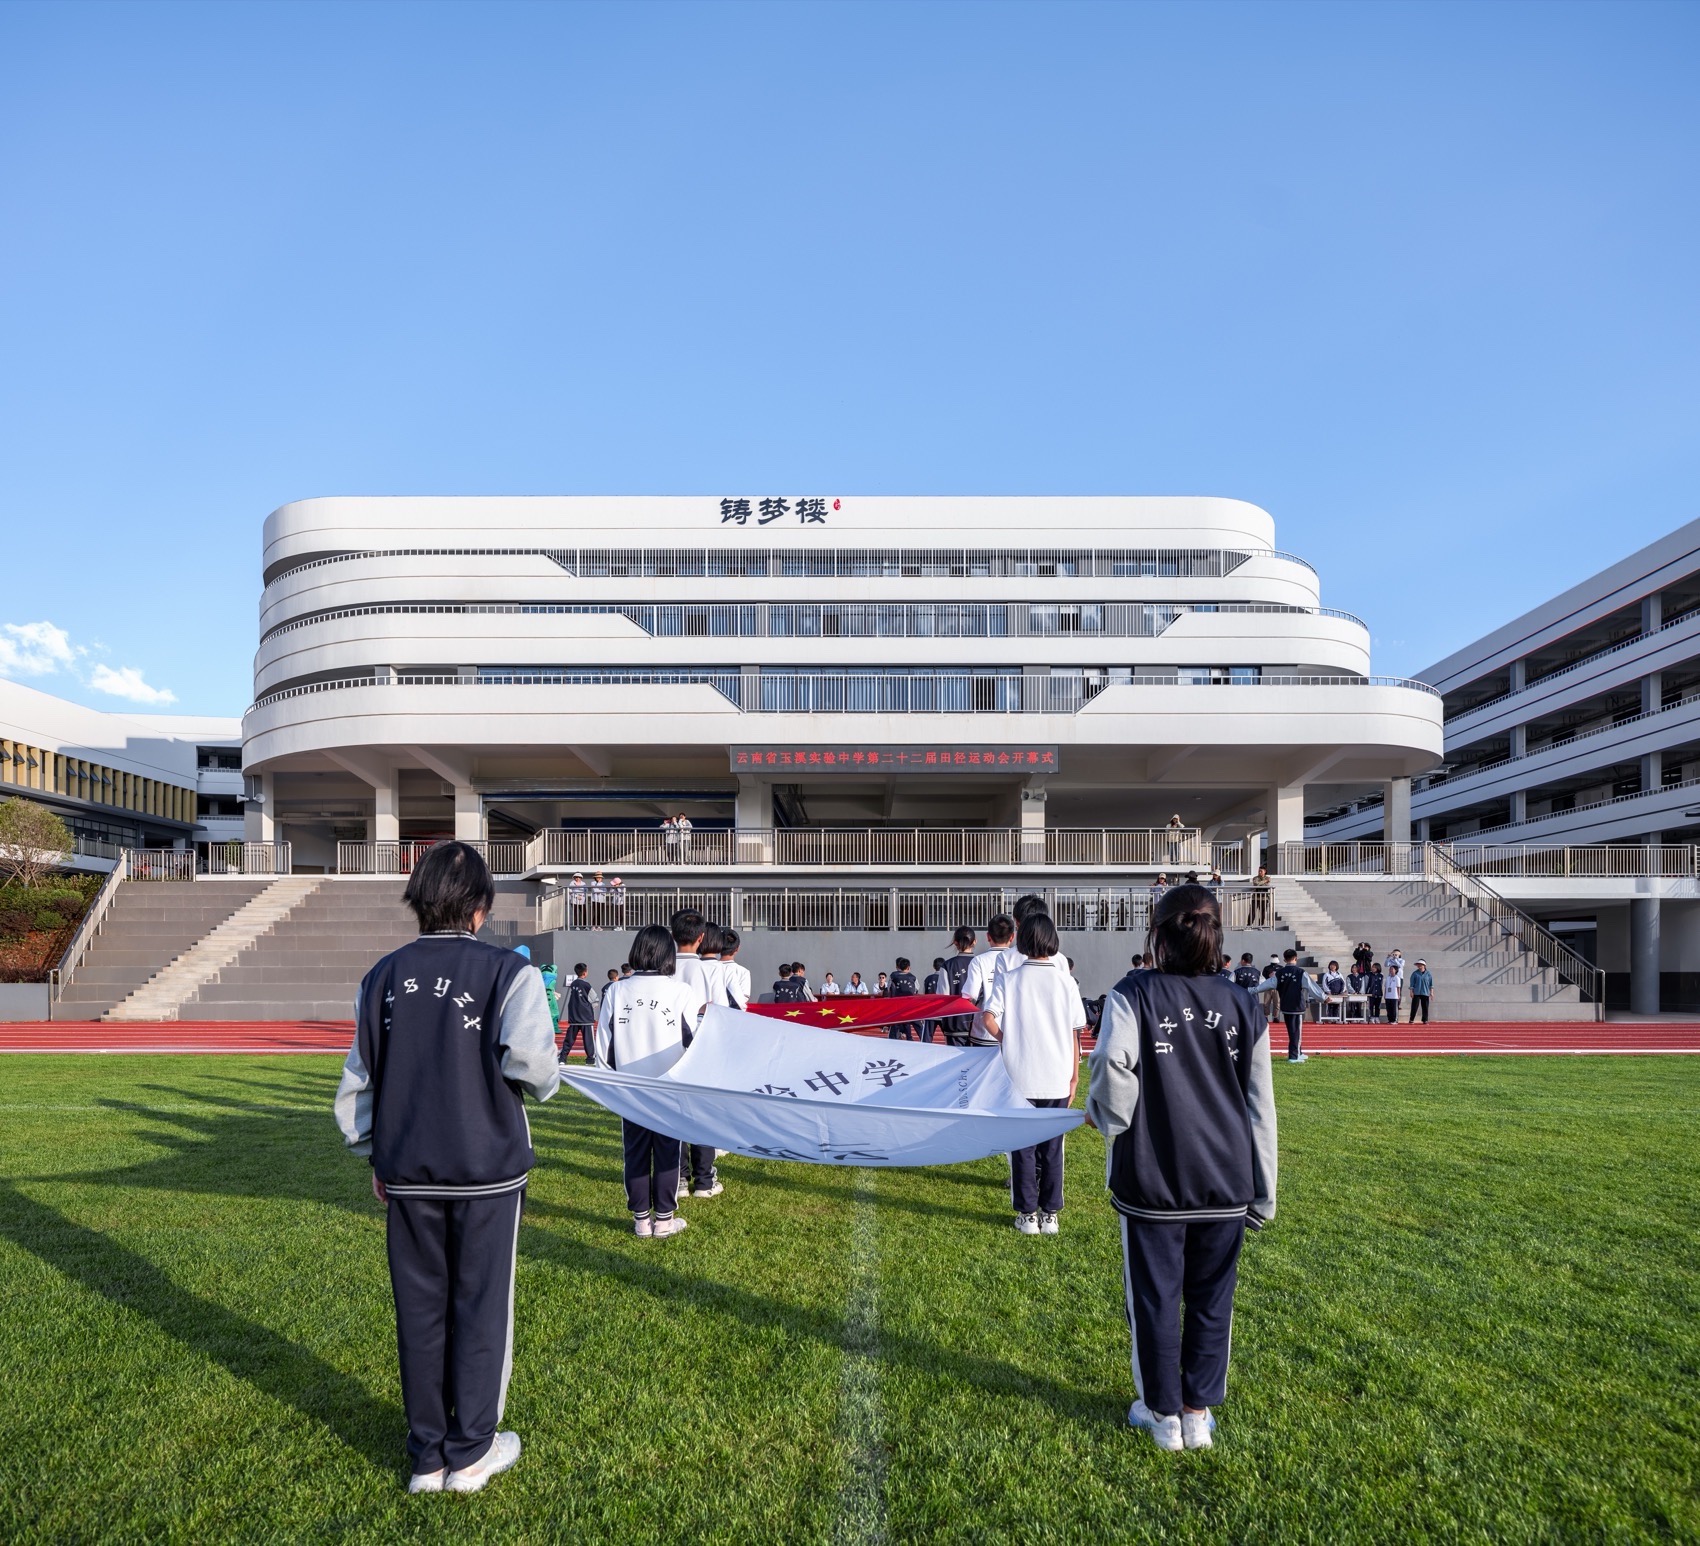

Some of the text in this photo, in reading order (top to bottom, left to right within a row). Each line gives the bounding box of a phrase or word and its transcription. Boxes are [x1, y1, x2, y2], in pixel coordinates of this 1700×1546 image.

[719, 497, 829, 525] 铸梦楼
[736, 751, 1054, 765] 云南省玉溪实验中学第二十二届田径运动会开幕式
